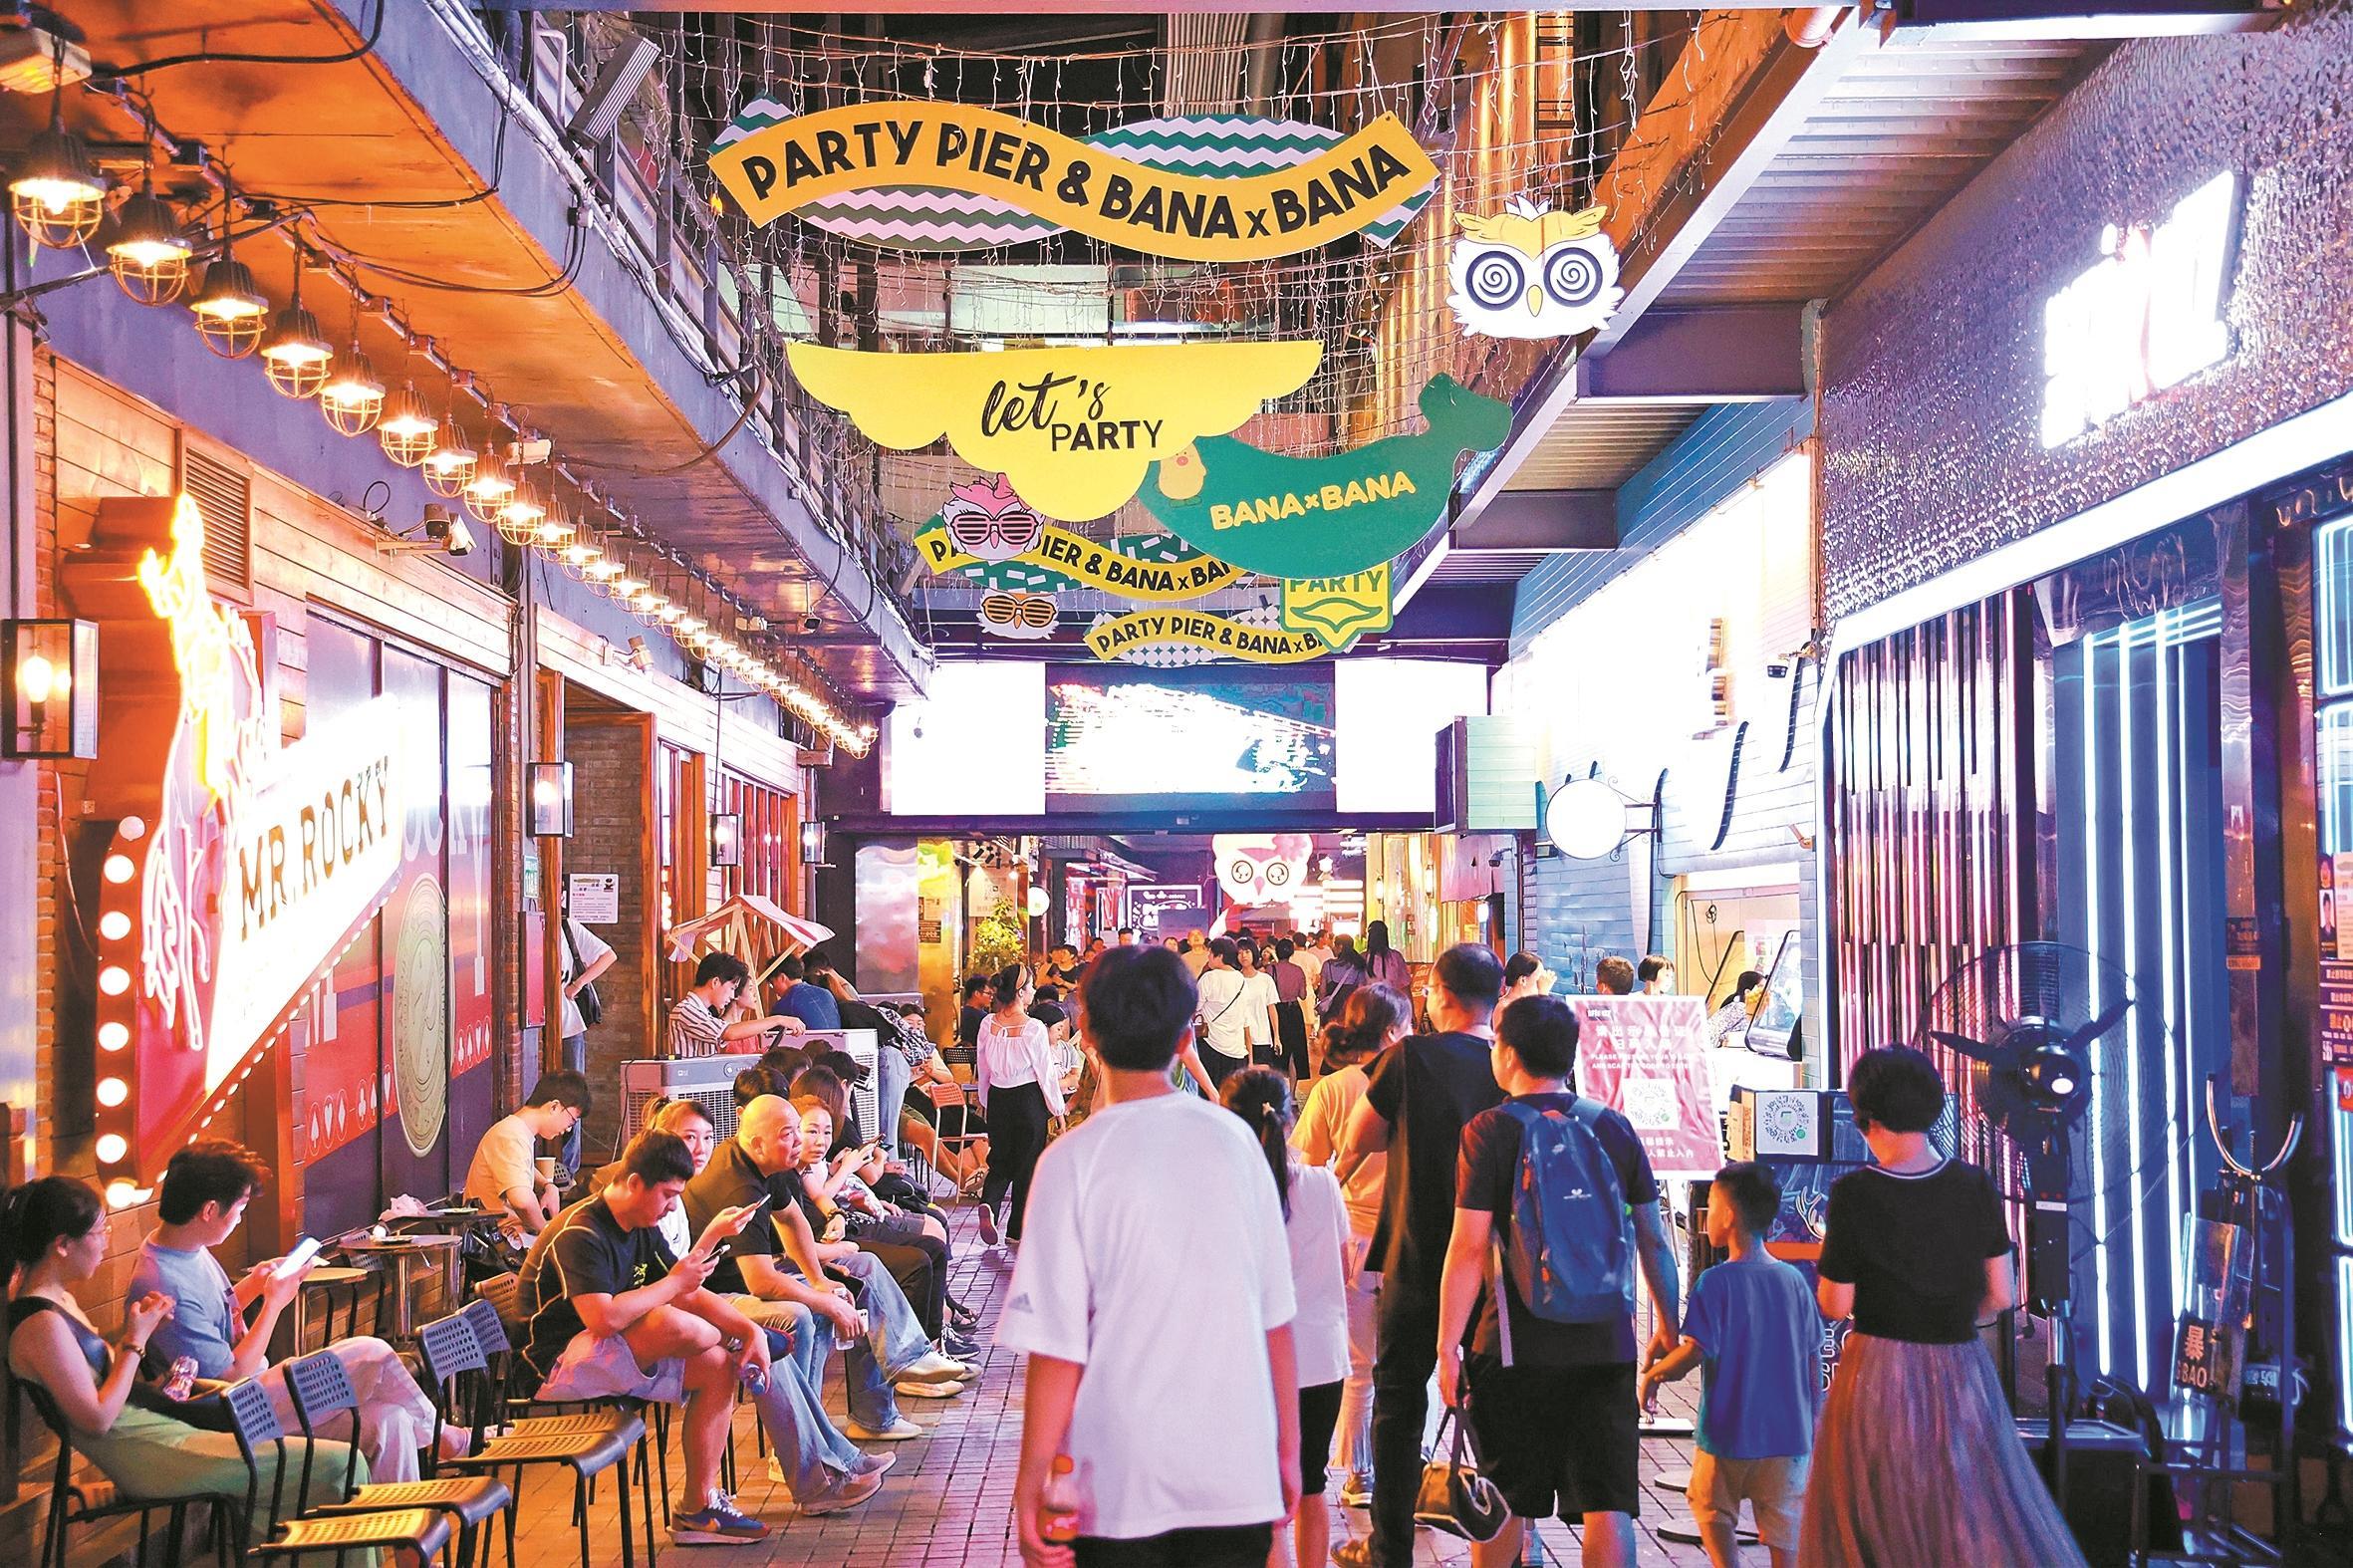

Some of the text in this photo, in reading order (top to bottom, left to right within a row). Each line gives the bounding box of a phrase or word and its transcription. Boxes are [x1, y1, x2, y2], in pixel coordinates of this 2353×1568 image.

[742, 121, 921, 201] PARTY
[935, 123, 1050, 192] PIER
[1056, 159, 1092, 207] &
[981, 372, 1110, 436] let's
[1051, 419, 1164, 452] PARTY
[1084, 553, 1103, 576] &
[1096, 617, 1166, 653] PARTY
[1171, 617, 1216, 641] PIER
[1218, 628, 1232, 646] &
[300, 755, 389, 895] ROCKY
